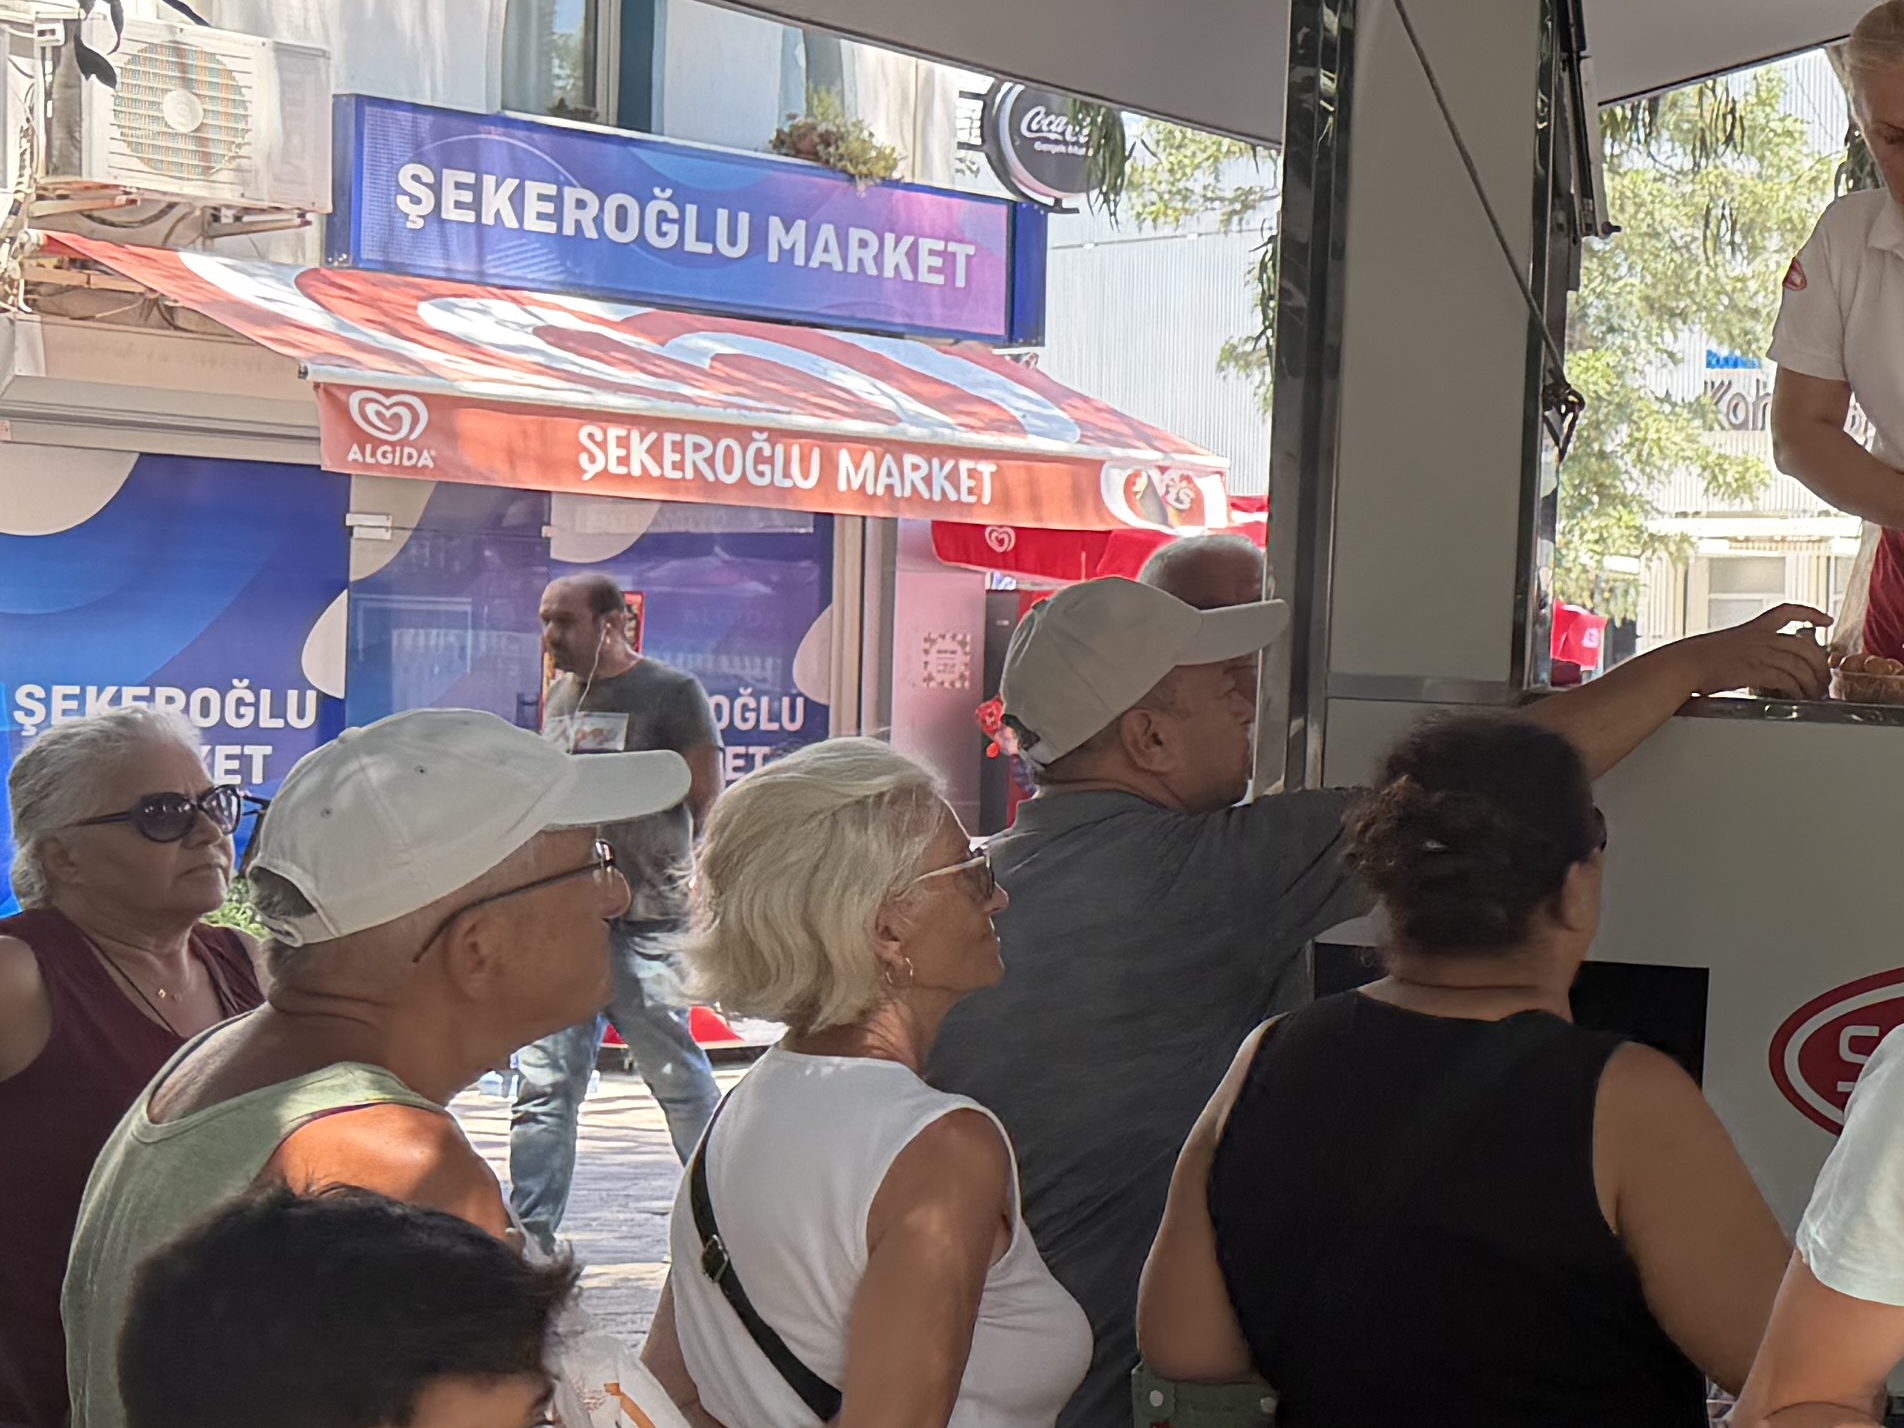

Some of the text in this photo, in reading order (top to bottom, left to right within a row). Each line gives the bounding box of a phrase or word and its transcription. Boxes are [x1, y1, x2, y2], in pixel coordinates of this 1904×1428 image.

[395, 163, 976, 288] ŞEKEROĞLU MARKET
[577, 424, 998, 506] ŞEKEROĞLU MARKET
